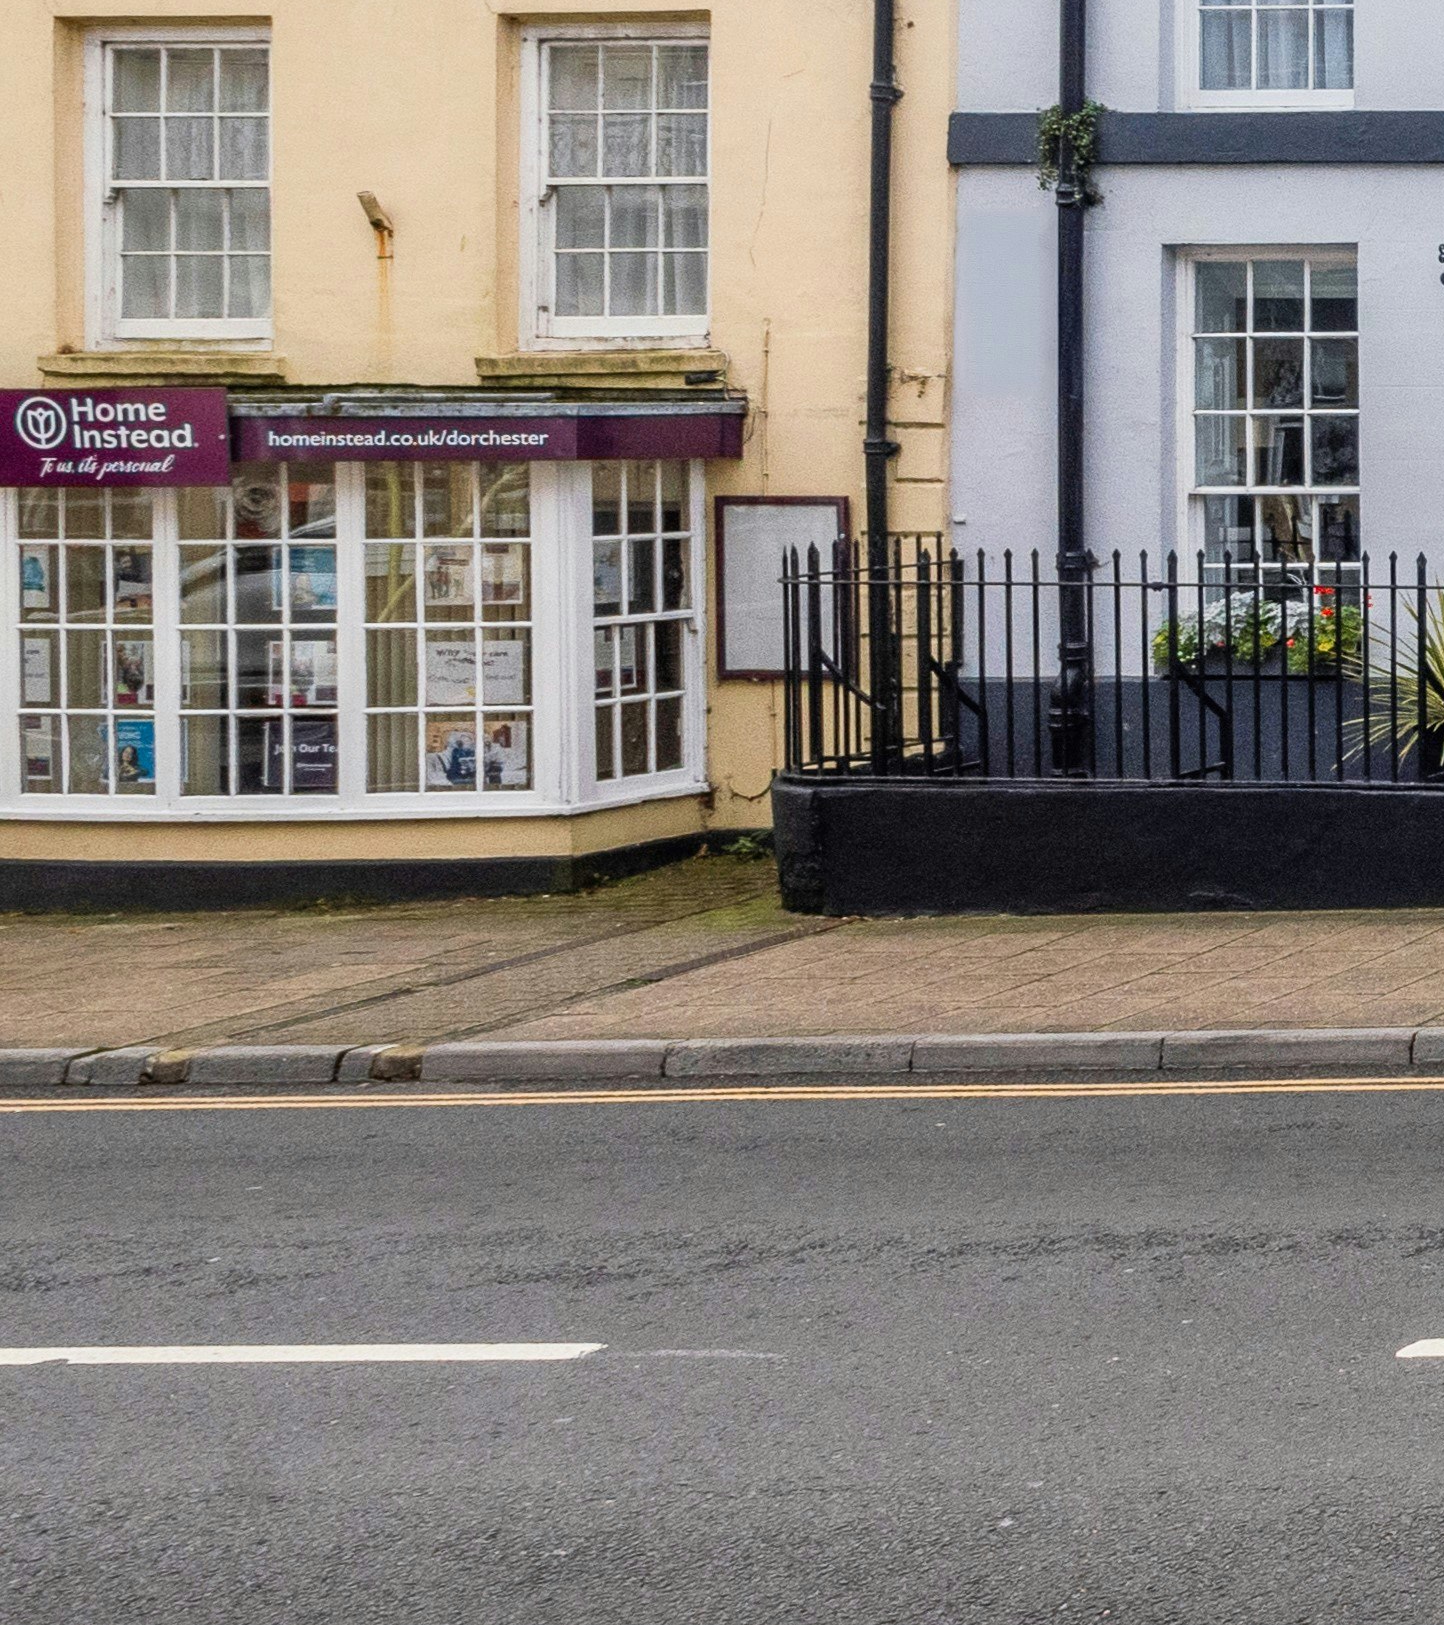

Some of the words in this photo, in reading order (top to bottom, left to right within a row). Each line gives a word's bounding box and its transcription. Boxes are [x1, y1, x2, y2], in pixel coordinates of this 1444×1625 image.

[70, 397, 167, 422] Home
[268, 430, 549, 447] homeinstead.co.uk/dorchester
[96, 454, 176, 480] personal
